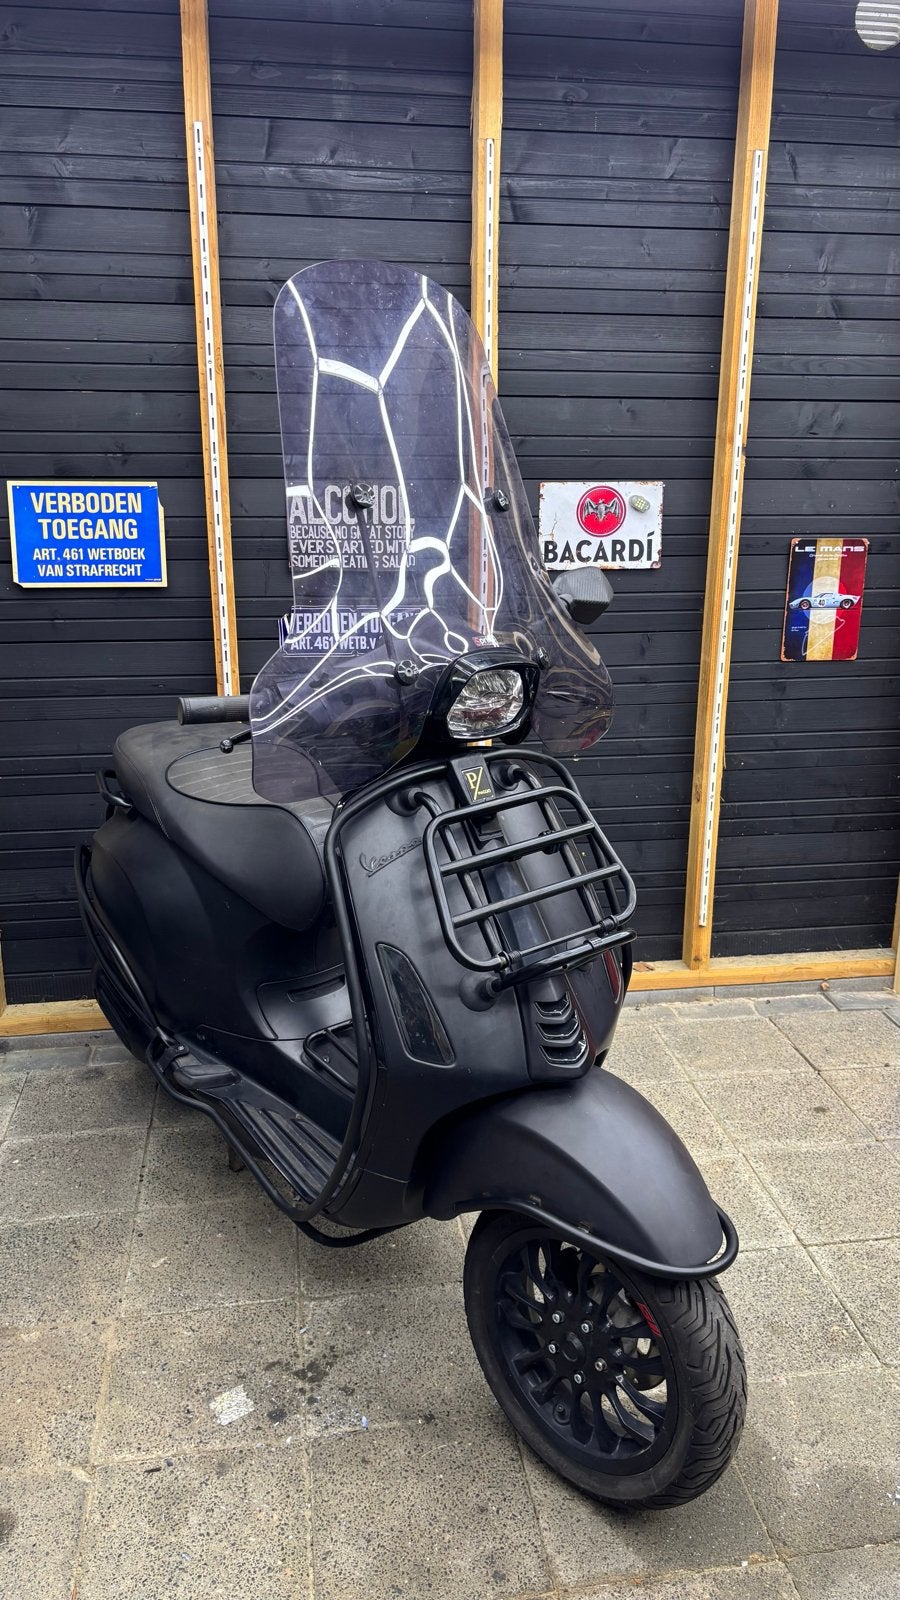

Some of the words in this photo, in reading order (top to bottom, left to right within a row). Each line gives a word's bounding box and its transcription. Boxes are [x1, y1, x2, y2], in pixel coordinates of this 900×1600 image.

[30, 492, 142, 514] VERBODEN
[38, 518, 138, 540] TOEGANG
[290, 525, 332, 539] BECAUSE
[334, 525, 348, 539] NO
[350, 525, 382, 539] GRAT
[291, 540, 325, 554] EVER
[386, 540, 414, 554] WIT
[543, 531, 655, 564] BACARDÍ
[795, 545, 816, 553] LE
[819, 545, 865, 553] MANS
[33, 548, 61, 561] ART.
[62, 548, 84, 561] 461
[87, 548, 145, 561] WETBOEK
[37, 564, 63, 577] VAN
[66, 564, 142, 577] STRAFRECHT
[284, 613, 357, 634] VERBOEN
